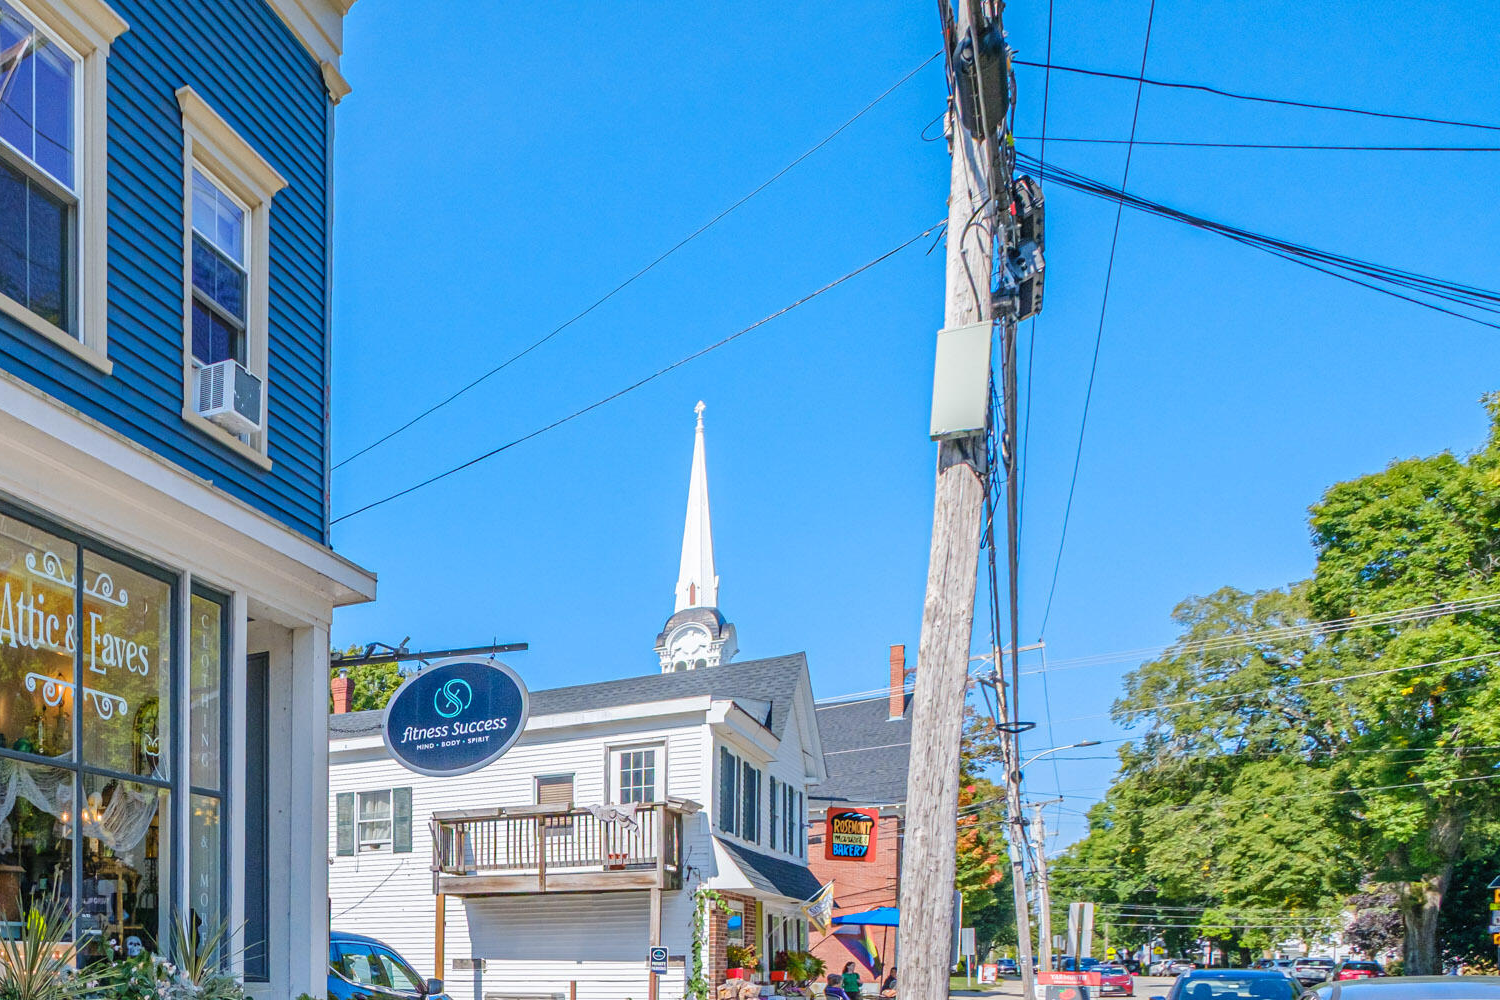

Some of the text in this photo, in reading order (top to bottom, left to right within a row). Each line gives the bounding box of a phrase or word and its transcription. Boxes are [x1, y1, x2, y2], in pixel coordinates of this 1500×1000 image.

[65, 614, 76, 653] &
[89, 611, 149, 677] Eaves
[200, 614, 210, 768] CLOTHING
[400, 716, 507, 744] fitness Success
[416, 735, 490, 751] MIND BODY SPIRIT
[833, 819, 873, 835] ROSEMONT
[833, 844, 868, 857] BAKERY
